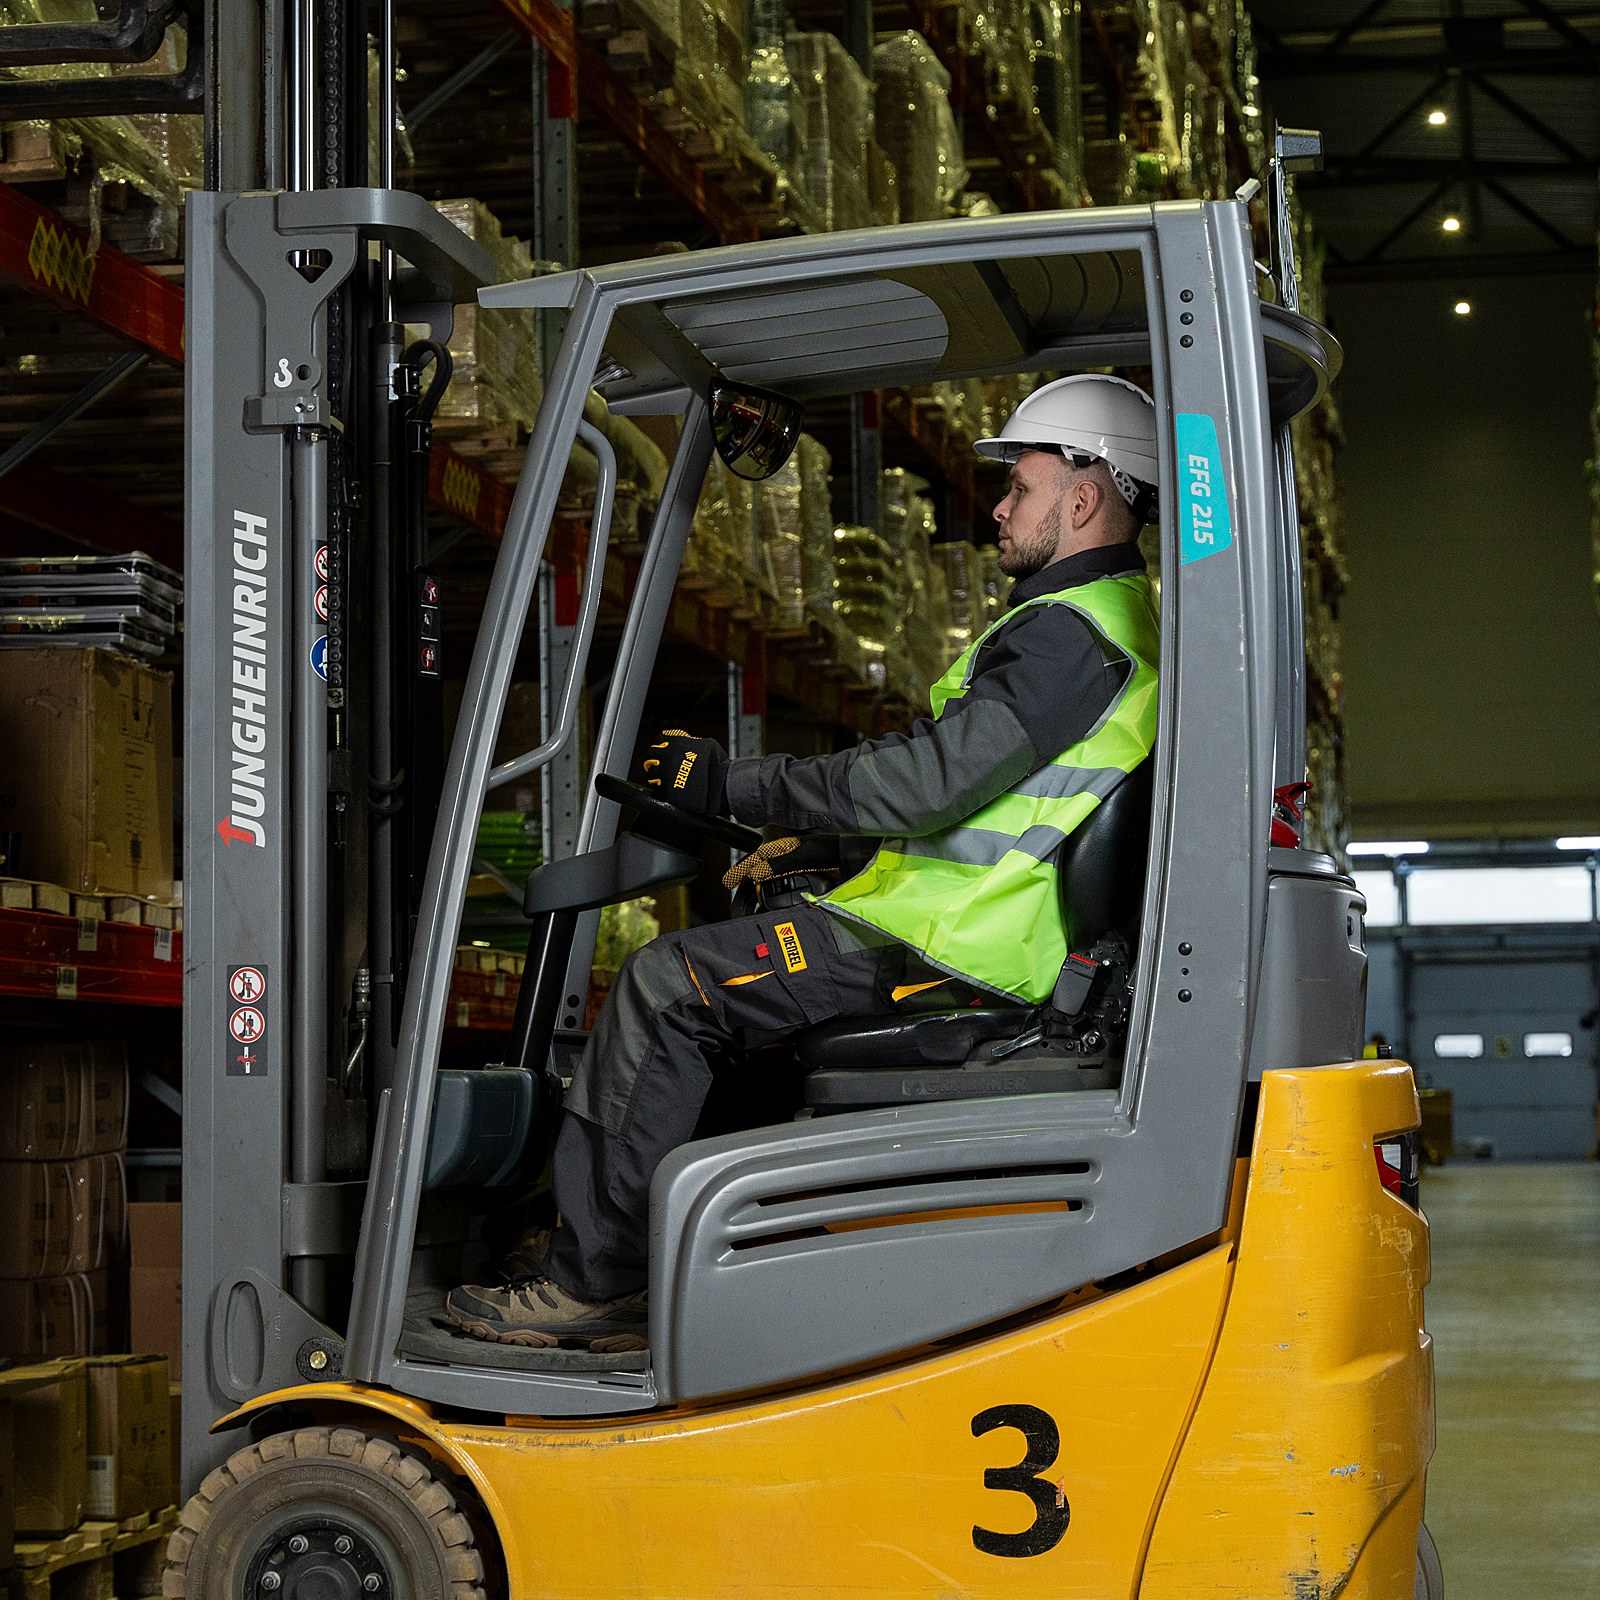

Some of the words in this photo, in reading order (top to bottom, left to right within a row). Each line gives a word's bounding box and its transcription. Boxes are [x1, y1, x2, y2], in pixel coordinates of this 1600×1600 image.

[1188, 454, 1210, 497] EFG
[1191, 503, 1214, 545] 215
[230, 509, 267, 848] JUNGHEINRICH
[673, 759, 694, 789] DENZEL
[783, 935, 802, 968] DENZEL
[925, 1075, 1029, 1095] GRAMMER
[971, 1404, 1071, 1558] 3
